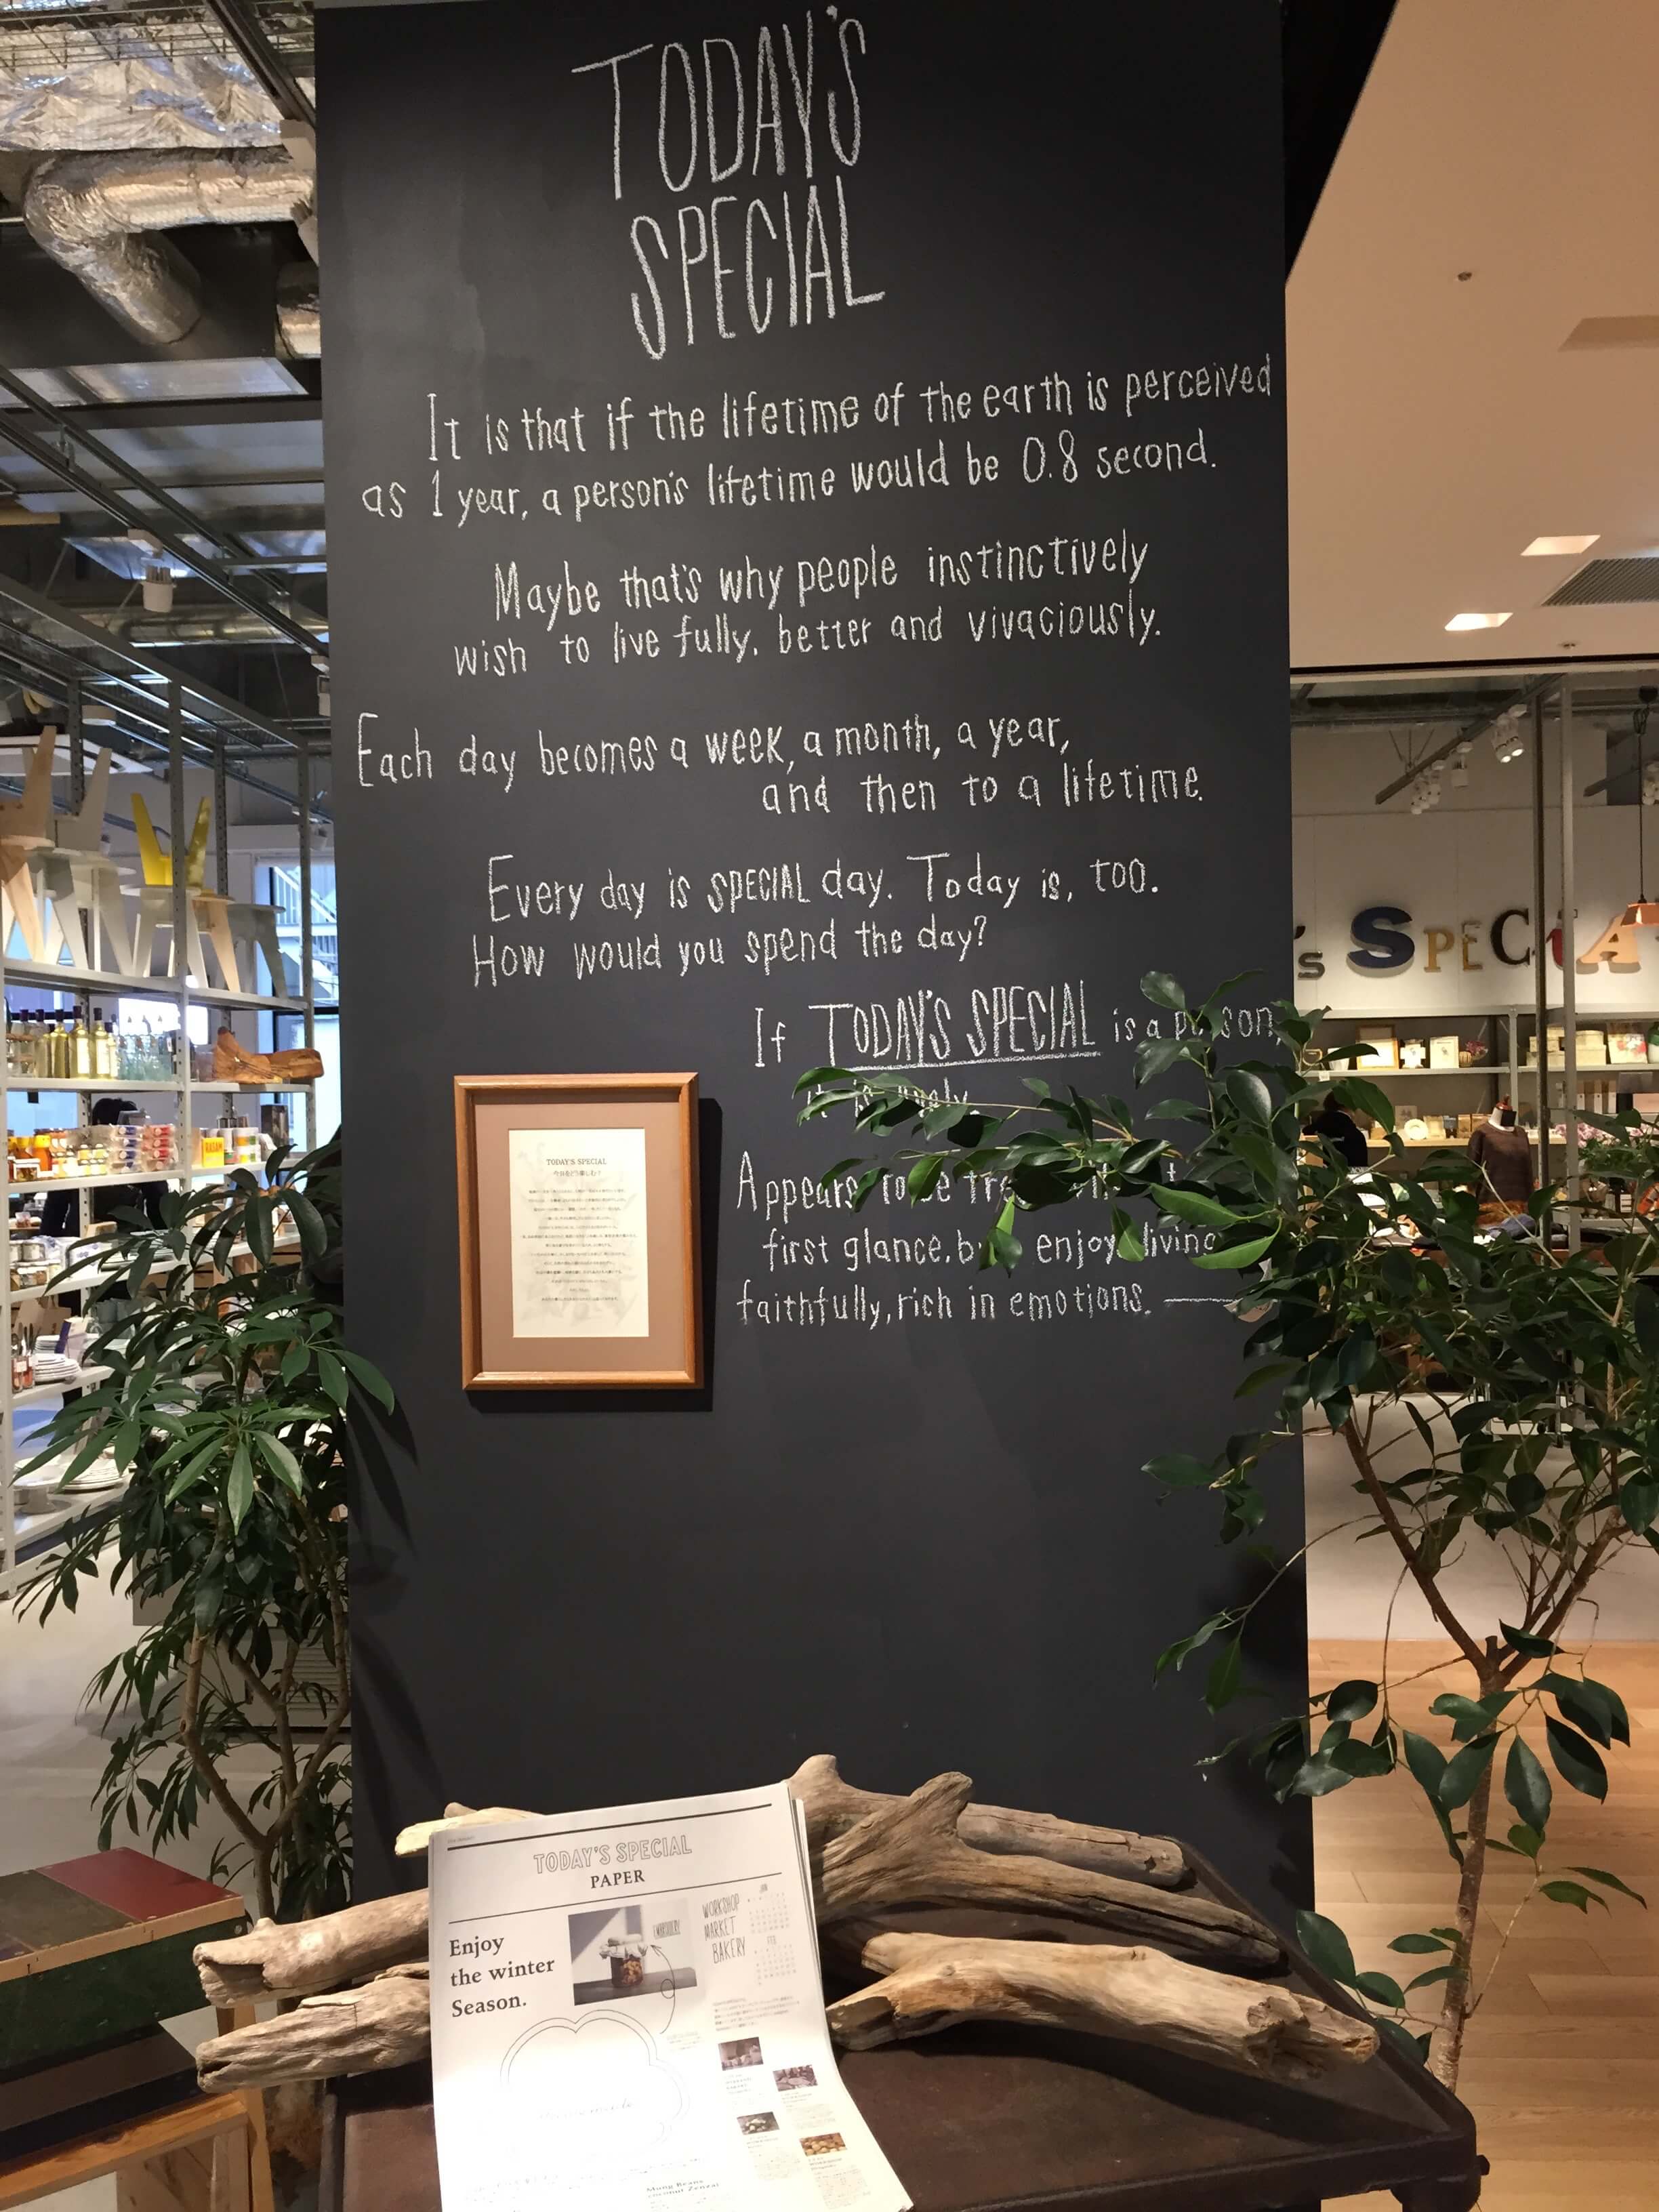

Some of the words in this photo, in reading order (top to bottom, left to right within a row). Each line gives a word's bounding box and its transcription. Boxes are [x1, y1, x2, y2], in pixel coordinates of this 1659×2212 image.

[571, 5, 867, 199] TODAY'S
[630, 175, 886, 360] SPECIAL
[428, 393, 461, 460] It
[487, 414, 509, 455] is
[521, 407, 586, 453] that
[607, 396, 634, 451] if
[649, 403, 705, 441] the
[722, 391, 859, 438] lifetime
[874, 382, 905, 426] of
[920, 381, 972, 424] the
[983, 371, 1073, 417] earth
[1086, 371, 1109, 411] is
[1126, 353, 1272, 417] perceived
[362, 482, 406, 518] as
[432, 469, 443, 516] 1
[542, 487, 562, 516] a
[575, 471, 689, 523] person's
[708, 462, 836, 507] lifetime
[851, 439, 951, 494] would
[966, 441, 1000, 486] be
[1022, 430, 1079, 483] 0.8
[1096, 428, 1216, 478] second.
[495, 560, 602, 632] Maybe
[619, 564, 703, 609] that's
[720, 555, 784, 610] why
[797, 544, 898, 609] people
[927, 528, 1149, 584] instinctively
[454, 638, 527, 677] wish
[560, 633, 590, 665] to
[613, 621, 659, 663] live
[778, 613, 873, 655] better
[890, 606, 943, 642] and
[968, 588, 1162, 647] vivaciously.
[357, 712, 433, 787] Each
[459, 734, 516, 794] day
[538, 729, 659, 777] becomes
[670, 736, 690, 770] a
[802, 730, 823, 758] a
[834, 713, 941, 760] month,
[957, 722, 977, 750] a
[988, 716, 1070, 758] year,
[761, 775, 831, 815] and
[859, 773, 936, 815] then
[961, 773, 998, 807] to
[1017, 774, 1042, 808] a
[1063, 758, 1204, 808] lifetime.
[487, 854, 584, 922] Every
[600, 868, 646, 920] day
[668, 867, 691, 909] is
[706, 863, 811, 914] SPECIAL
[821, 858, 893, 909] day.
[906, 851, 1020, 909] Today
[1040, 868, 1073, 903] is,
[473, 934, 544, 987] How
[573, 933, 663, 981] would
[679, 937, 725, 977] you
[744, 918, 838, 976] spend
[854, 920, 903, 958] the
[917, 913, 987, 962] day?
[754, 1006, 786, 1068] If
[808, 989, 951, 1069] TODAY'S
[966, 980, 1097, 1059] SPECIAL
[1113, 1008, 1136, 1043] is
[1145, 1018, 1163, 1040] a
[1174, 1005, 1282, 1047] pson,
[737, 1151, 859, 1225] Appears
[762, 1227, 829, 1272] first
[737, 1279, 890, 1330] faithfully,
[899, 1287, 953, 1320] rich
[969, 1285, 996, 1321] in
[533, 1845, 611, 1875] TODAY'S
[616, 1834, 693, 1864] SPECIAL
[590, 1868, 646, 1889] PAPER
[702, 1893, 740, 1919] WORKSHOP
[704, 1915, 737, 1942] MARKET
[449, 1933, 506, 1961] Enjoy
[450, 1968, 482, 1988] the
[488, 1957, 555, 1982] winter
[712, 1936, 746, 1965] BAKERY
[451, 1994, 528, 2018] Season.
